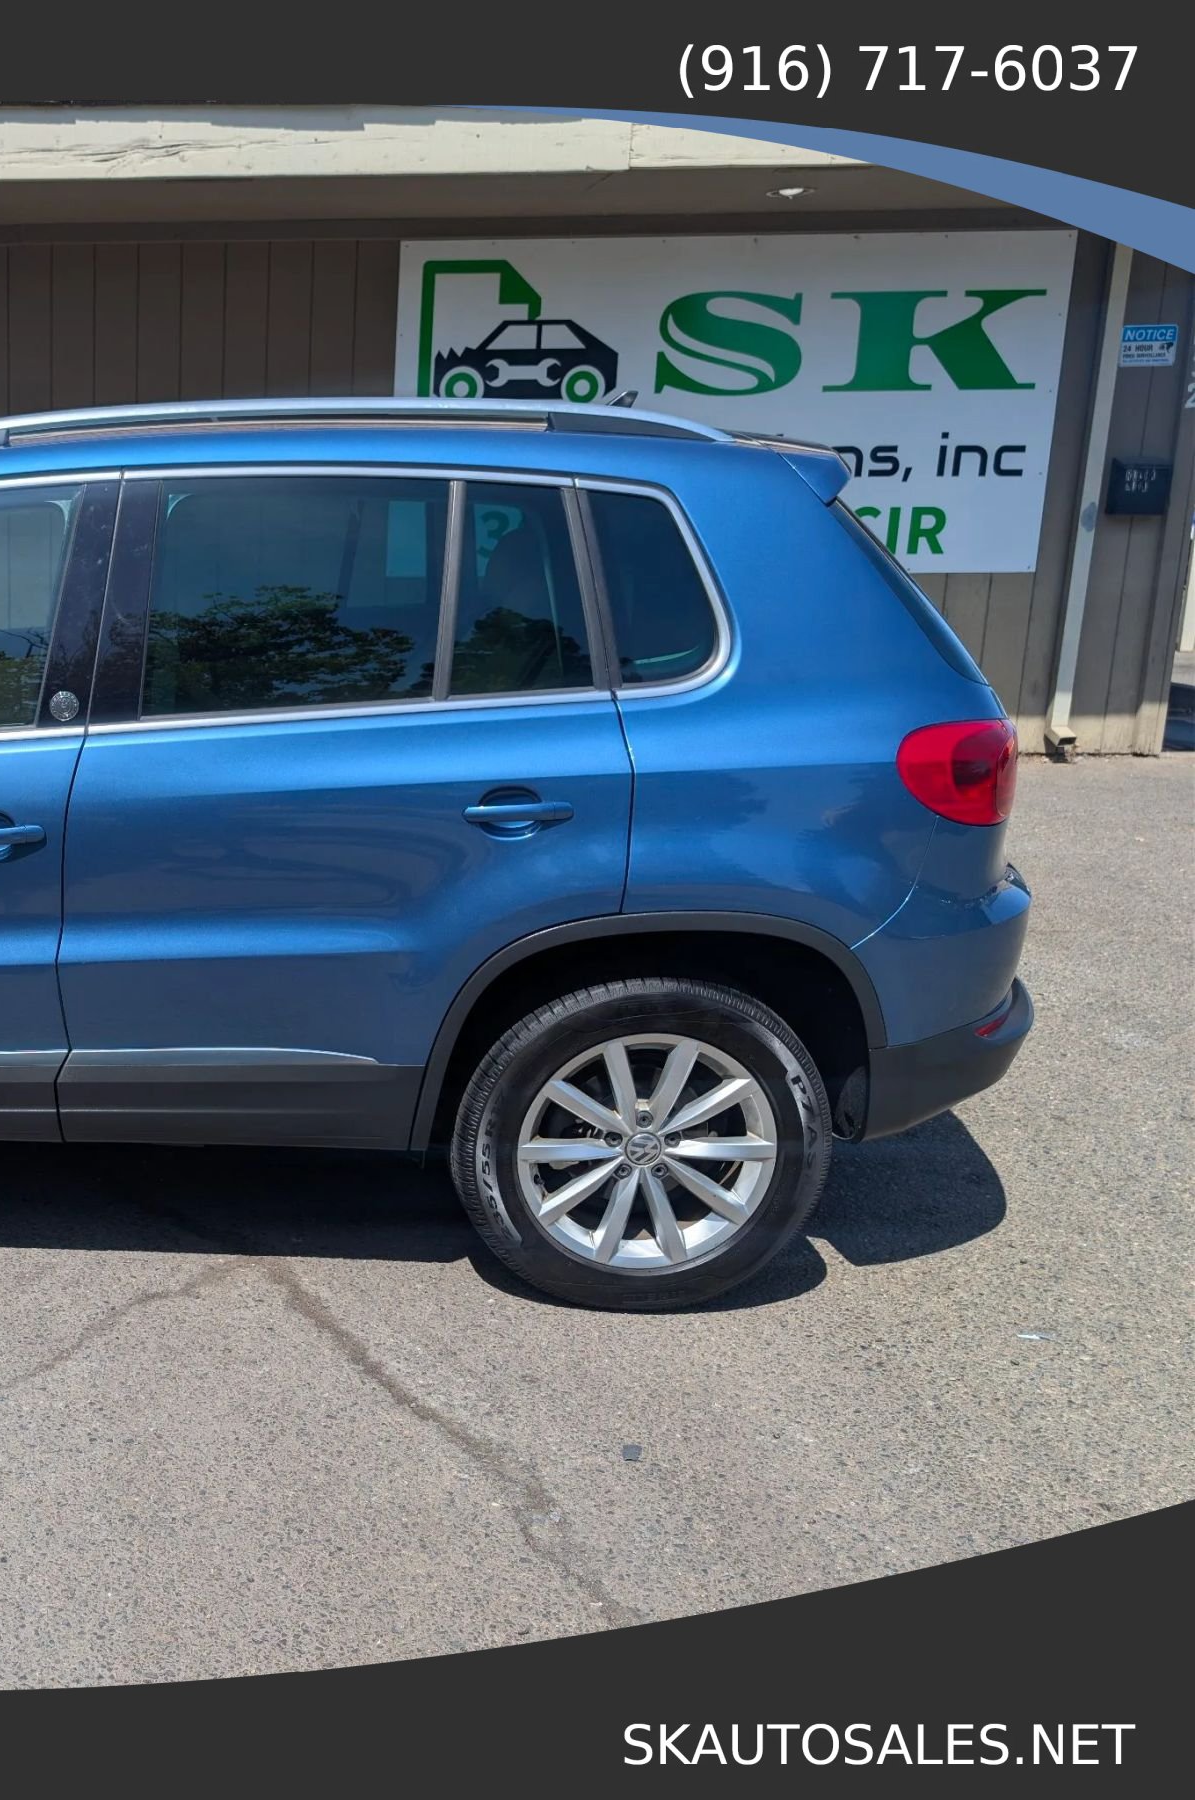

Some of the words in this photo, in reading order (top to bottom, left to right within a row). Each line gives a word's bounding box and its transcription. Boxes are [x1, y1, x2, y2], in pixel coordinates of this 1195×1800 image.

[654, 289, 1047, 395] SK
[1123, 345, 1132, 353] 24
[1135, 344, 1154, 352] HOUR
[1124, 328, 1175, 341] NOTICE
[936, 432, 1027, 477] inc
